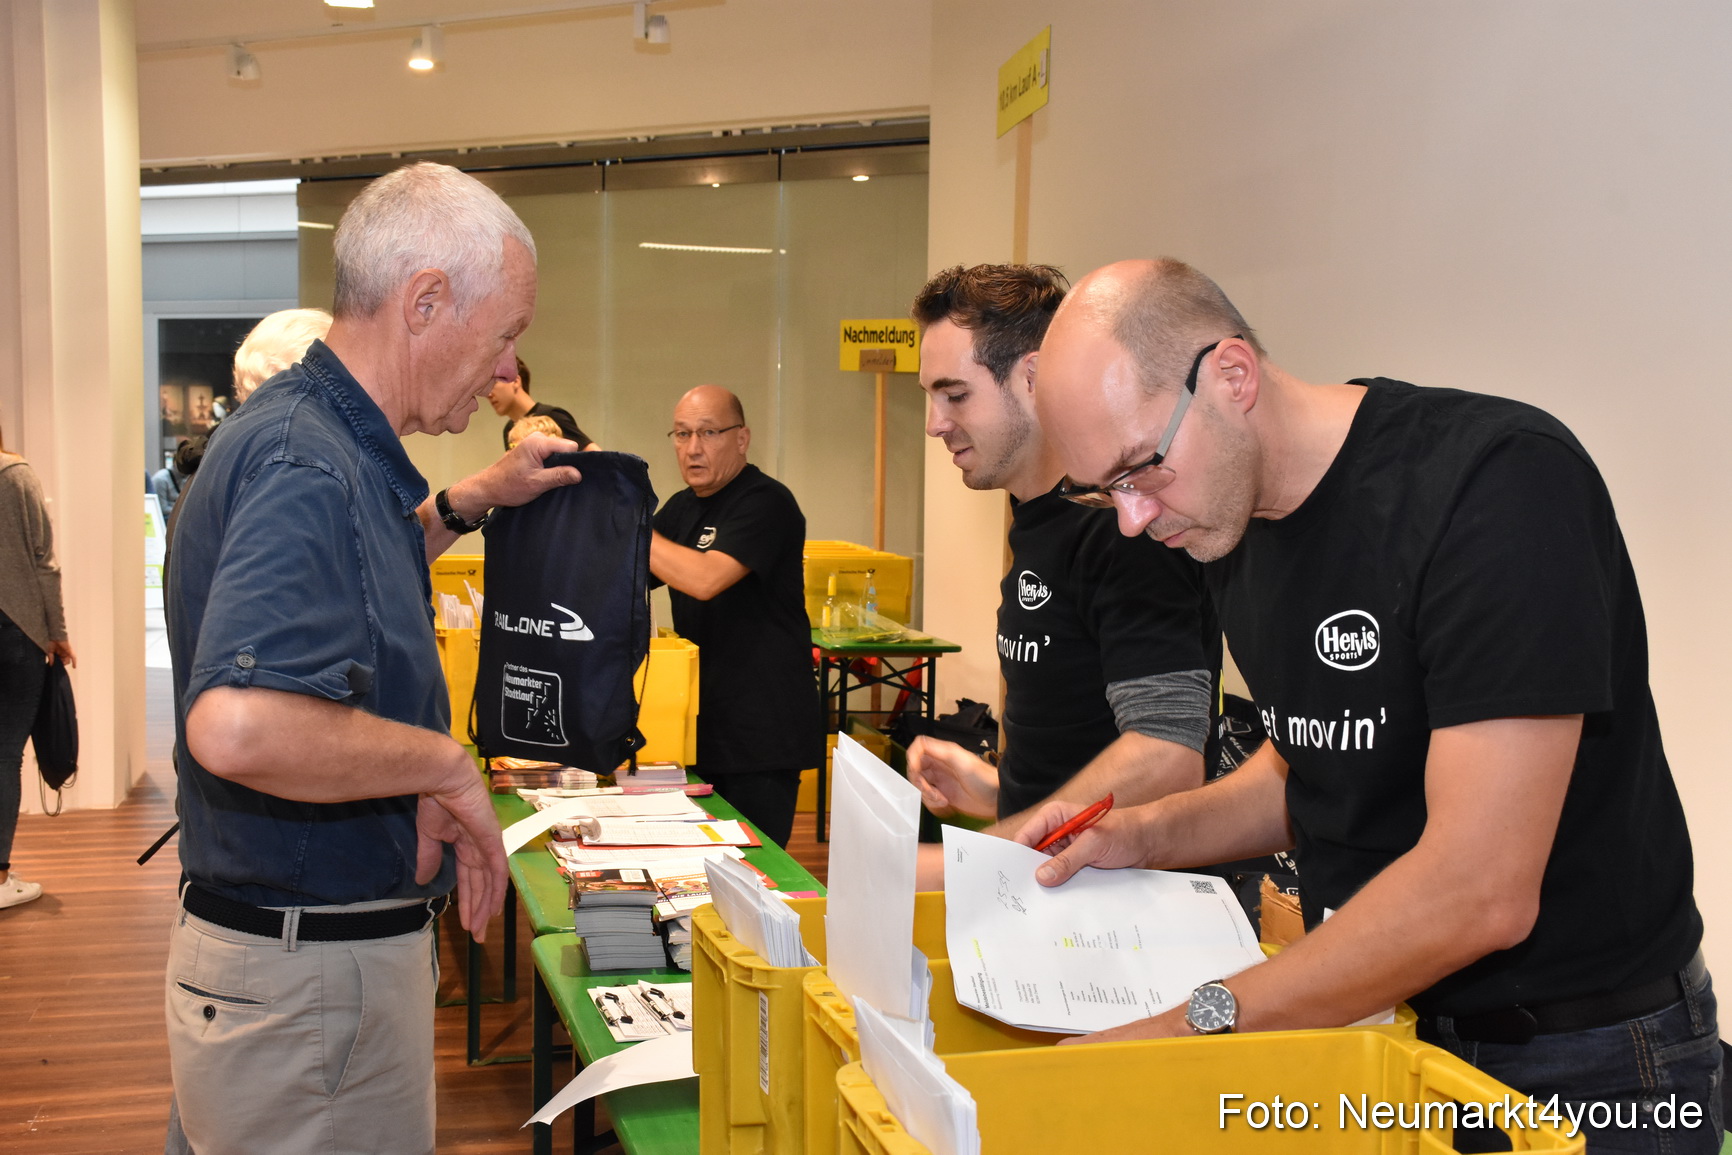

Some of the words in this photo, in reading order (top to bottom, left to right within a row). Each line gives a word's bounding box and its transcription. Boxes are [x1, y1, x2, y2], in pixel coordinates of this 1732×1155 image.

[1019, 66, 1032, 97] Lauf
[1032, 63, 1037, 87] A
[843, 325, 916, 348] Nachmeldung
[1020, 579, 1049, 601] Hervis
[1322, 625, 1378, 657] Hervis
[1329, 651, 1358, 661] SPORTS
[519, 665, 529, 673] des
[504, 672, 543, 689] Neumarkter
[504, 686, 535, 704] Stadtlauf
[1257, 705, 1280, 741] et
[1287, 706, 1387, 751] movin'
